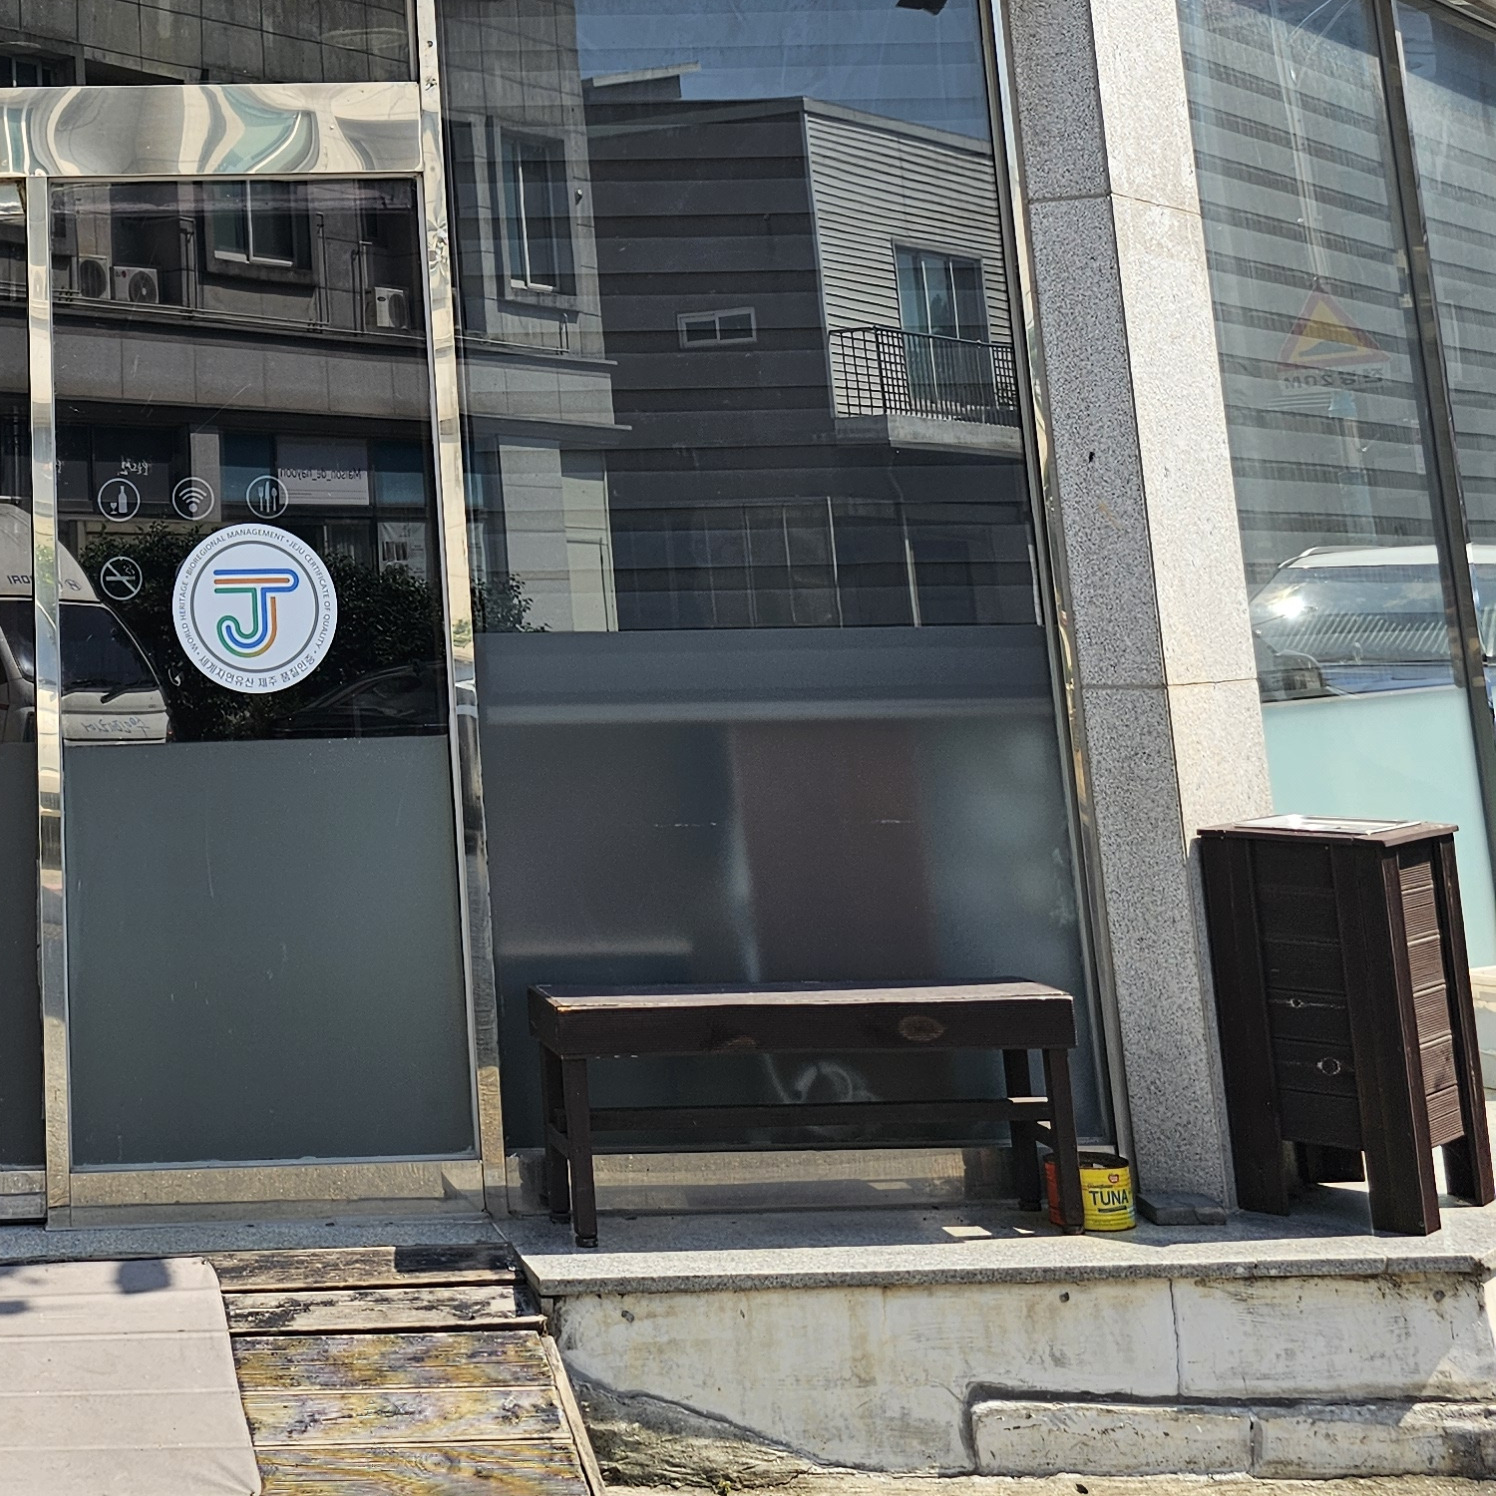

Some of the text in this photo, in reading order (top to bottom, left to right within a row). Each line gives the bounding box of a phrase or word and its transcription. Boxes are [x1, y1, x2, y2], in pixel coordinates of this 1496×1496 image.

[227, 528, 285, 543] MANAGEMENT
[289, 541, 305, 556] JEJU
[187, 535, 226, 577] BIOREGIONAL
[304, 553, 330, 601] CERTIFICATE
[178, 581, 188, 622] HERITAGE
[183, 623, 199, 655] WORLD
[316, 613, 331, 649] QUALITY
[198, 656, 254, 688] 세계자연유산
[258, 674, 279, 688] 제주
[1088, 1189, 1129, 1206] TUNA
